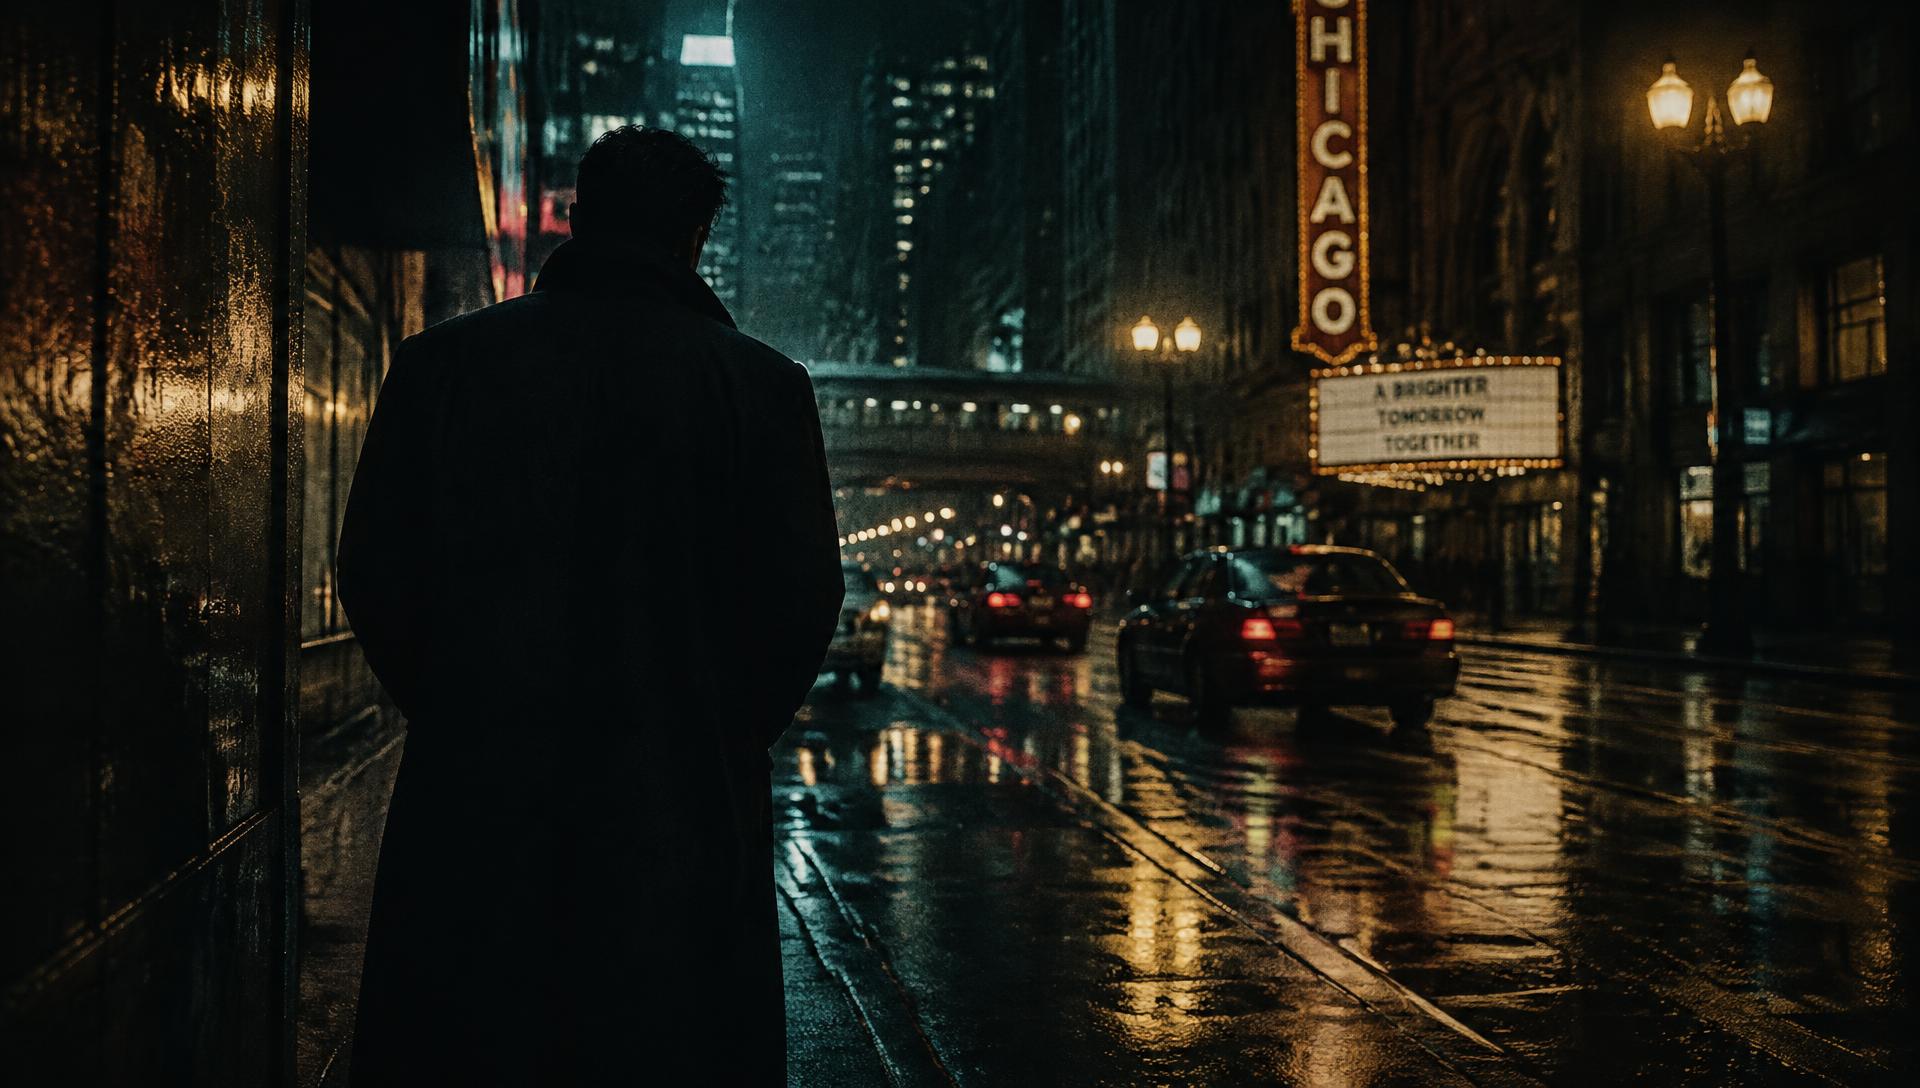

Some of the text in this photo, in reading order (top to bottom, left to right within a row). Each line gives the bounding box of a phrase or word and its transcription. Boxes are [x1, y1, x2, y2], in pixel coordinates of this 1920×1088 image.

[1310, 0, 1356, 335] HICAGO
[1373, 375, 1489, 399] A BRIGHTER
[1377, 406, 1486, 426] TOMORROW
[1384, 432, 1481, 452] TOGETHER
